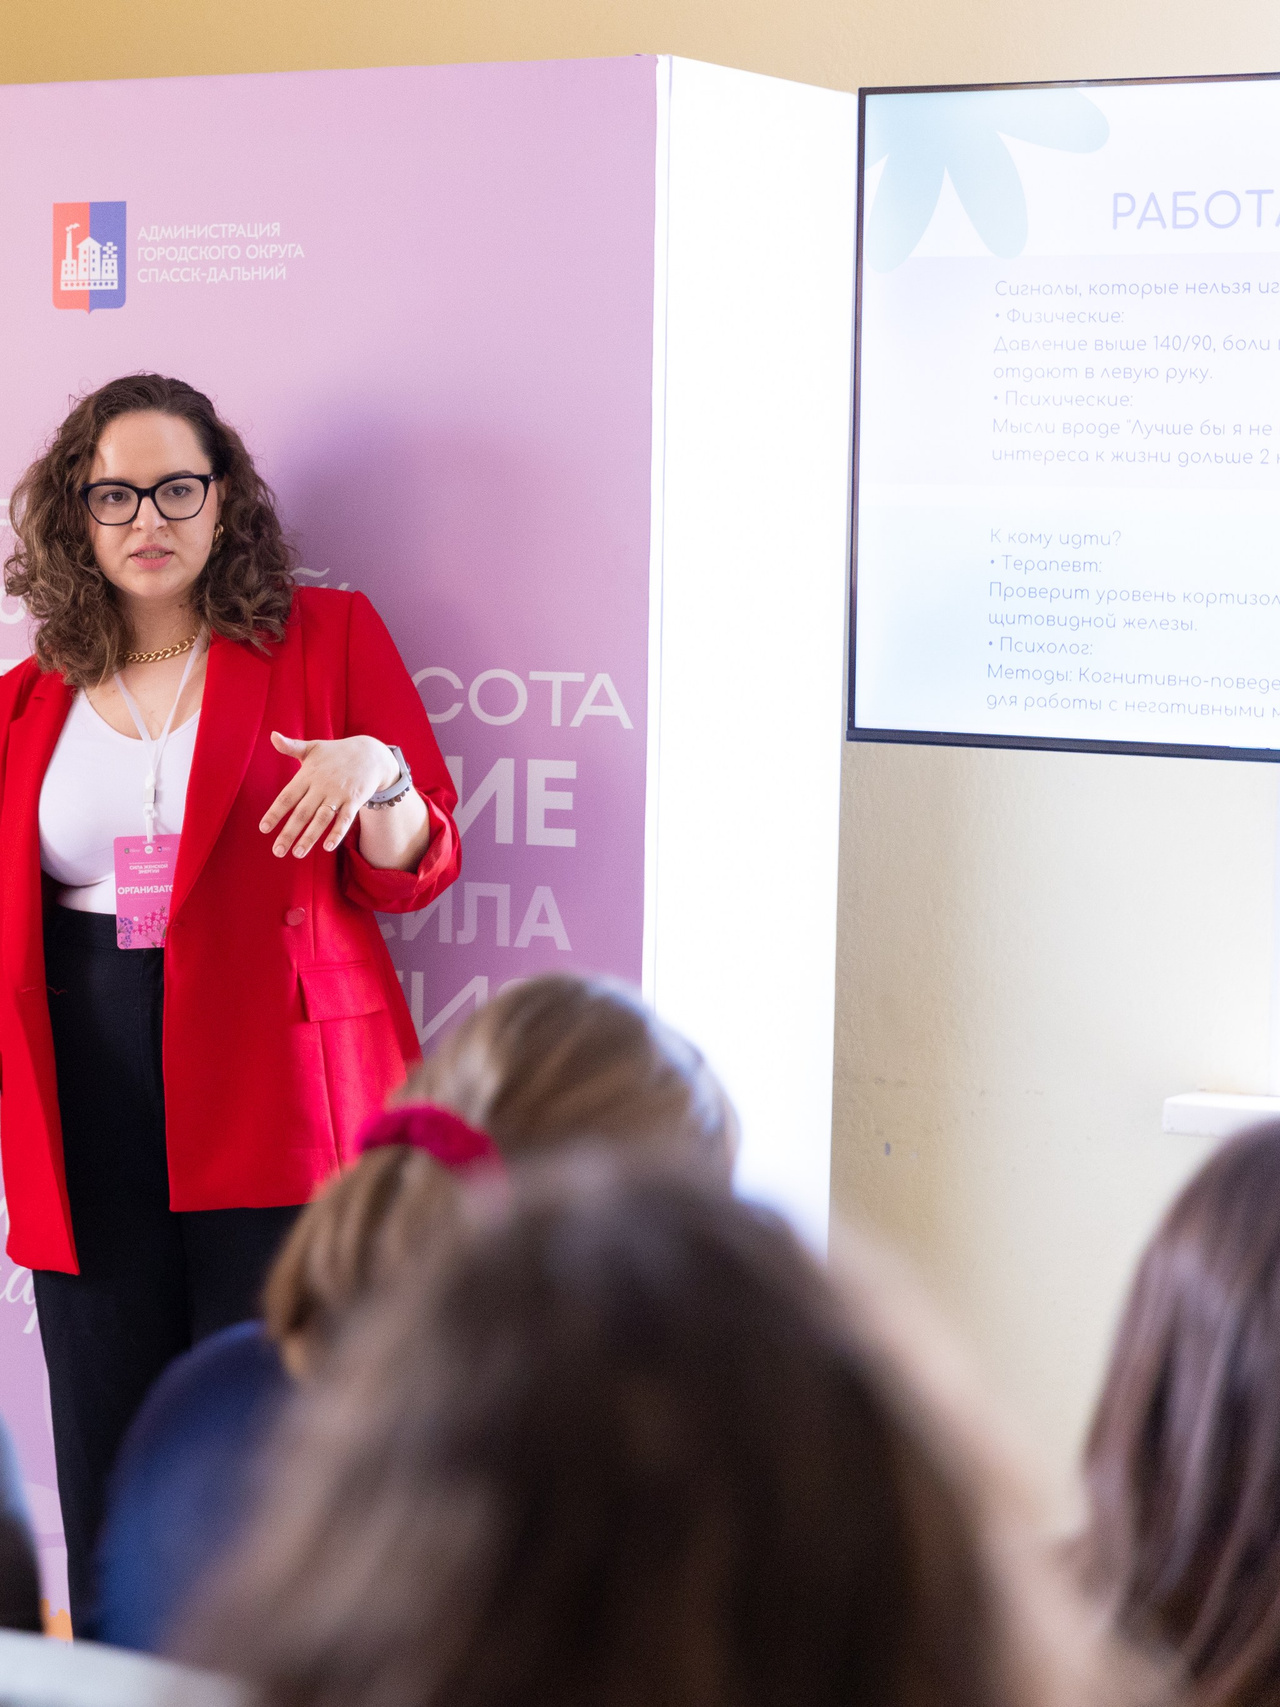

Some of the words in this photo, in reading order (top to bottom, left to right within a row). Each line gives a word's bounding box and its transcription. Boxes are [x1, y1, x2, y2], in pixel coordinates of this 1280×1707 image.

[1113, 189, 1280, 230] РАБОТ
[137, 222, 280, 242] АДМИНИСТРАЦИЯ
[138, 245, 241, 263] ГОРОДСКОГО
[246, 243, 305, 259] ОКРУГА
[137, 263, 286, 284] СПАССК-ДАЛЬНИЙ
[995, 280, 1082, 297] Сигналы,
[1089, 283, 1179, 299] которые
[1186, 282, 1251, 294] нельзя
[1007, 308, 1124, 323] Физические:
[993, 336, 1087, 353] Давление
[1095, 339, 1147, 351] выше
[1154, 335, 1216, 352] 140/90,
[1223, 335, 1270, 351] боли
[993, 367, 1078, 383] отдают
[1085, 367, 1094, 379] в
[1101, 367, 1159, 383] левую
[1166, 367, 1213, 384] руку.
[1006, 390, 1133, 407] Психические:
[993, 418, 1055, 433] Мысли
[1063, 423, 1120, 438] вроде
[1127, 419, 1193, 439] "Лучше
[1200, 419, 1225, 435] бы
[1233, 424, 1241, 435] я
[1249, 425, 1272, 436] не
[992, 450, 1089, 465] интереса
[1096, 451, 1104, 461] к
[1111, 451, 1170, 463] жизни
[1178, 452, 1253, 467] дольше
[1260, 448, 1269, 464] 2
[991, 529, 1001, 543] К
[1008, 533, 1052, 549] кому
[1059, 530, 1121, 549] идти?
[1001, 555, 1102, 575] Терапевт:
[990, 582, 1089, 603] Проверит
[1096, 589, 1176, 605] уровень
[989, 614, 1115, 631] щитовидной
[1123, 617, 1197, 631] железы.
[1000, 636, 1093, 655] Психолог:
[987, 663, 1073, 685] Методы:
[987, 695, 1017, 710] для
[1024, 692, 1101, 711] работы
[1109, 699, 1117, 711] с
[1125, 701, 1264, 717] негативными
[375, 880, 574, 952] ИЛА
